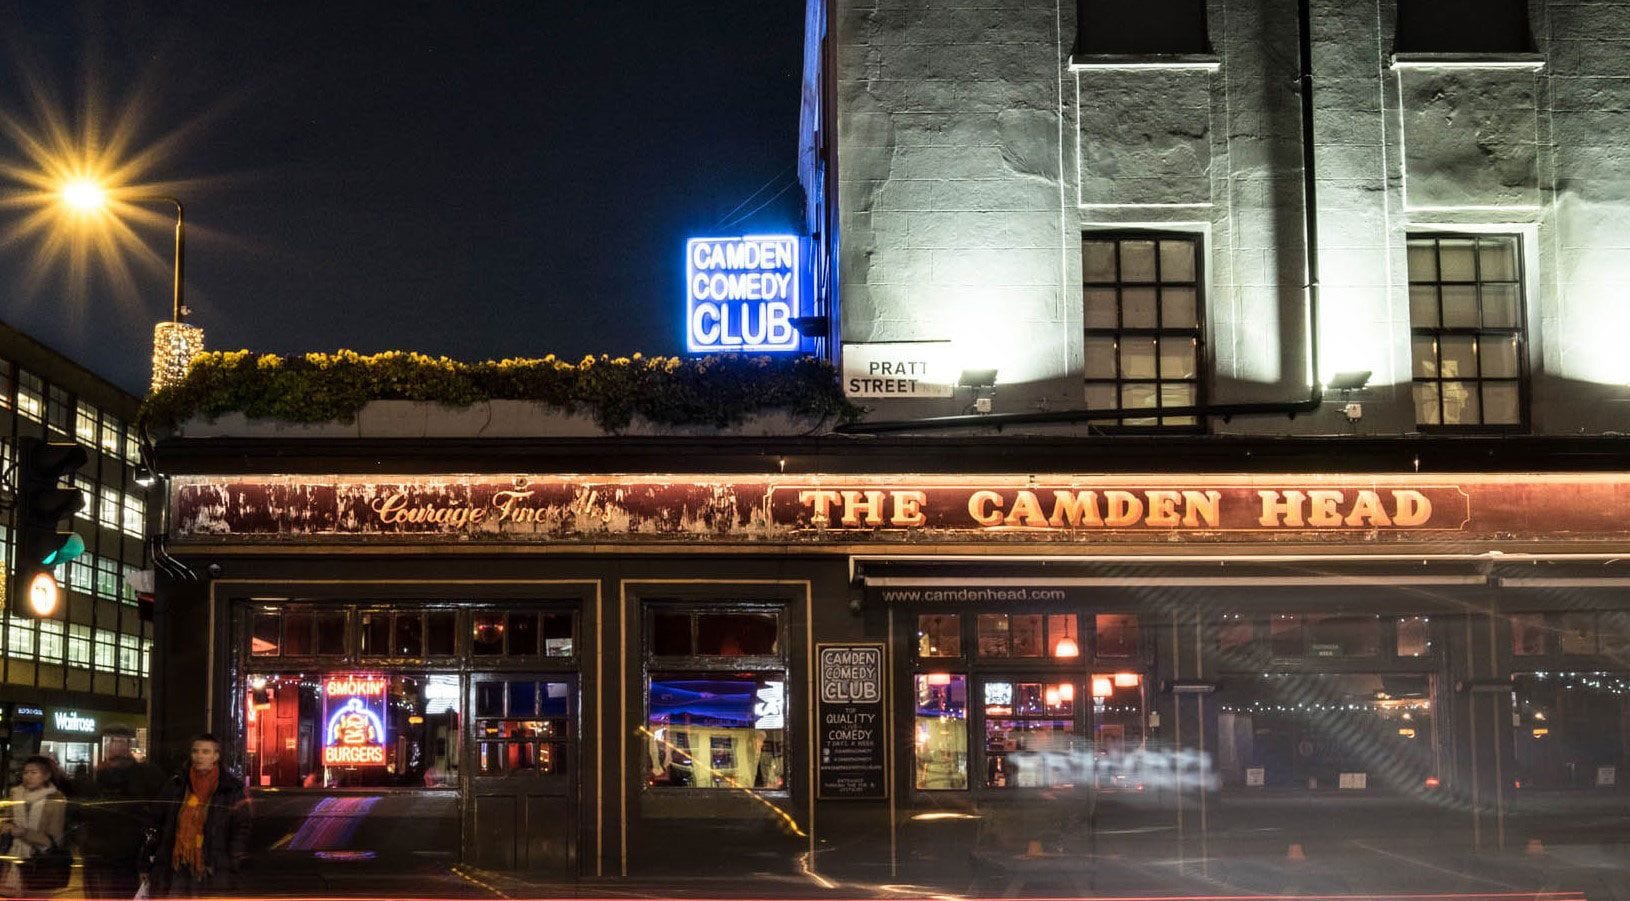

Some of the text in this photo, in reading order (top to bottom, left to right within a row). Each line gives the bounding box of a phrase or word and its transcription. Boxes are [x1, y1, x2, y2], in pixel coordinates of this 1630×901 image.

[693, 241, 792, 270] CAMDEN
[692, 272, 792, 301] COMEDY
[692, 301, 793, 346] CLUB
[869, 361, 928, 375] PRATT
[850, 379, 918, 393] STREET
[371, 493, 484, 528] Courage
[799, 489, 1433, 528] THE CAMDEN HEAD
[883, 588, 1066, 602] www.camdenhead.com
[825, 652, 876, 666] CAMDEN
[825, 667, 876, 681] COMEDY
[327, 680, 385, 696] SMOKIN'
[825, 681, 877, 700] CLUB
[54, 711, 95, 732] Waitrose
[826, 713, 876, 724] QUALITY
[828, 730, 873, 741] COMEDY
[325, 746, 383, 763] BURGERS
